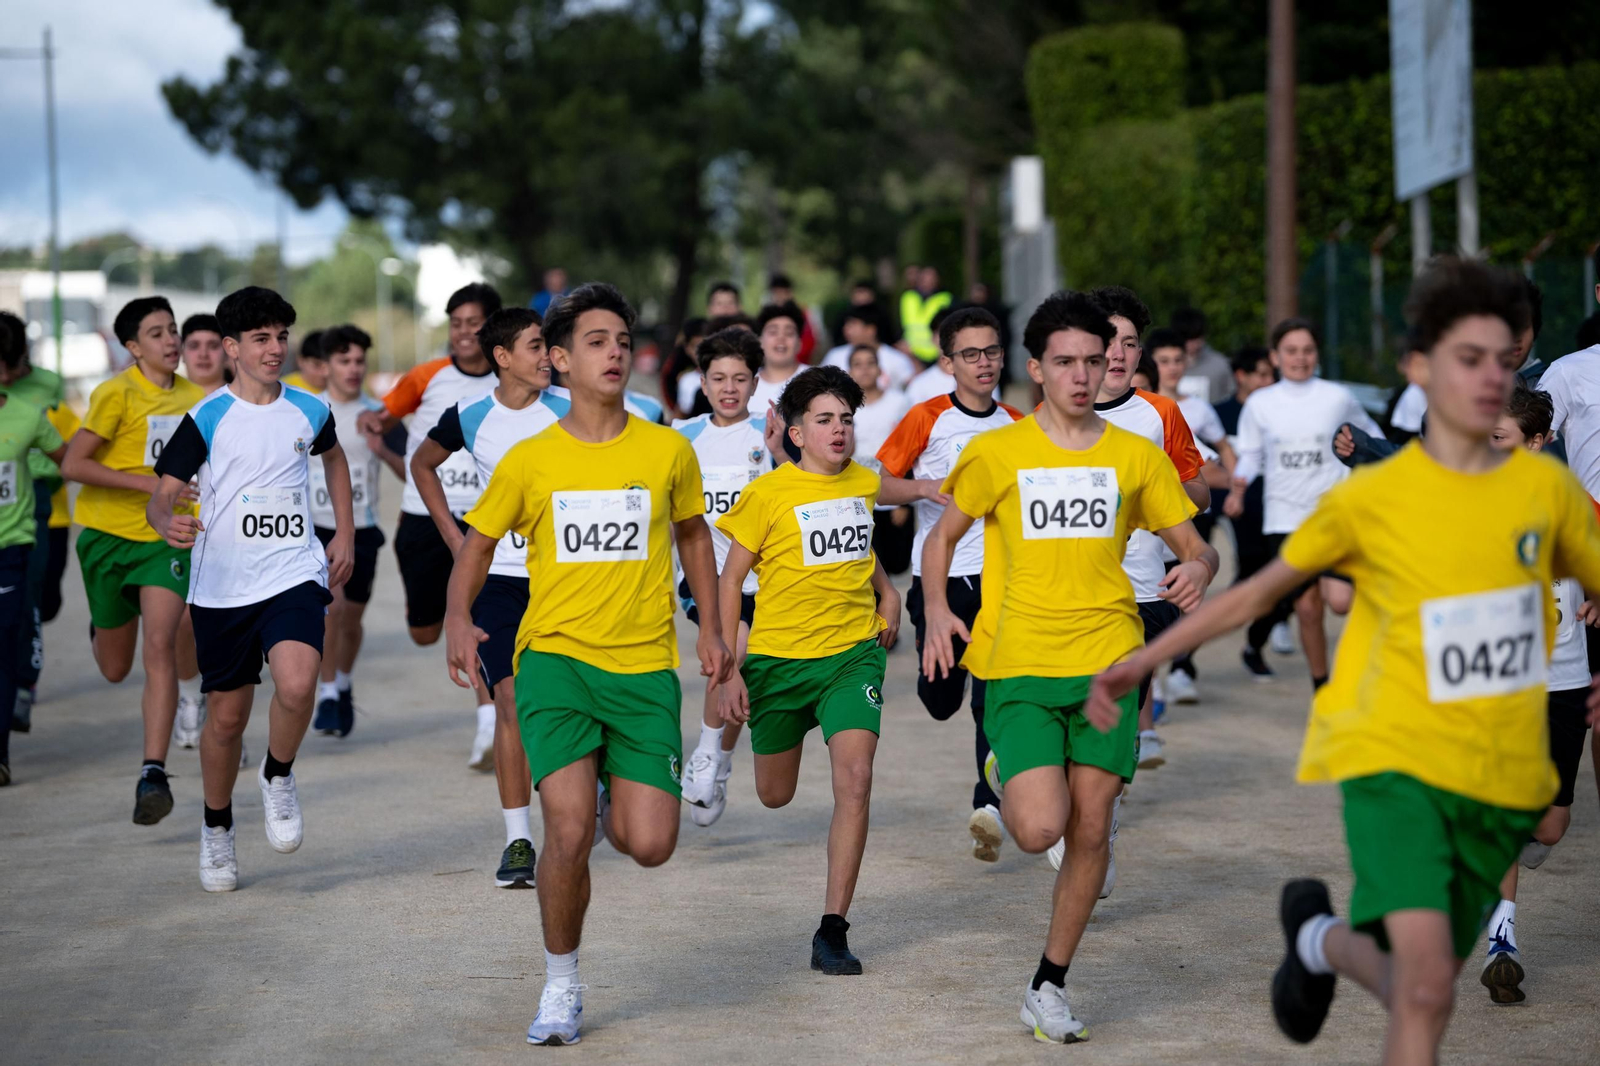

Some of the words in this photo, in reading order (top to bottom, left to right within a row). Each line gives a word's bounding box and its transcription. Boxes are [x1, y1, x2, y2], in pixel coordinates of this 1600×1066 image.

[1280, 450, 1322, 470] 0274
[439, 468, 480, 488] 344
[242, 514, 304, 538] 0503
[1030, 498, 1107, 530] 0426
[564, 522, 639, 553] 0422
[809, 524, 868, 557] 0425
[1441, 632, 1534, 685] 0427
